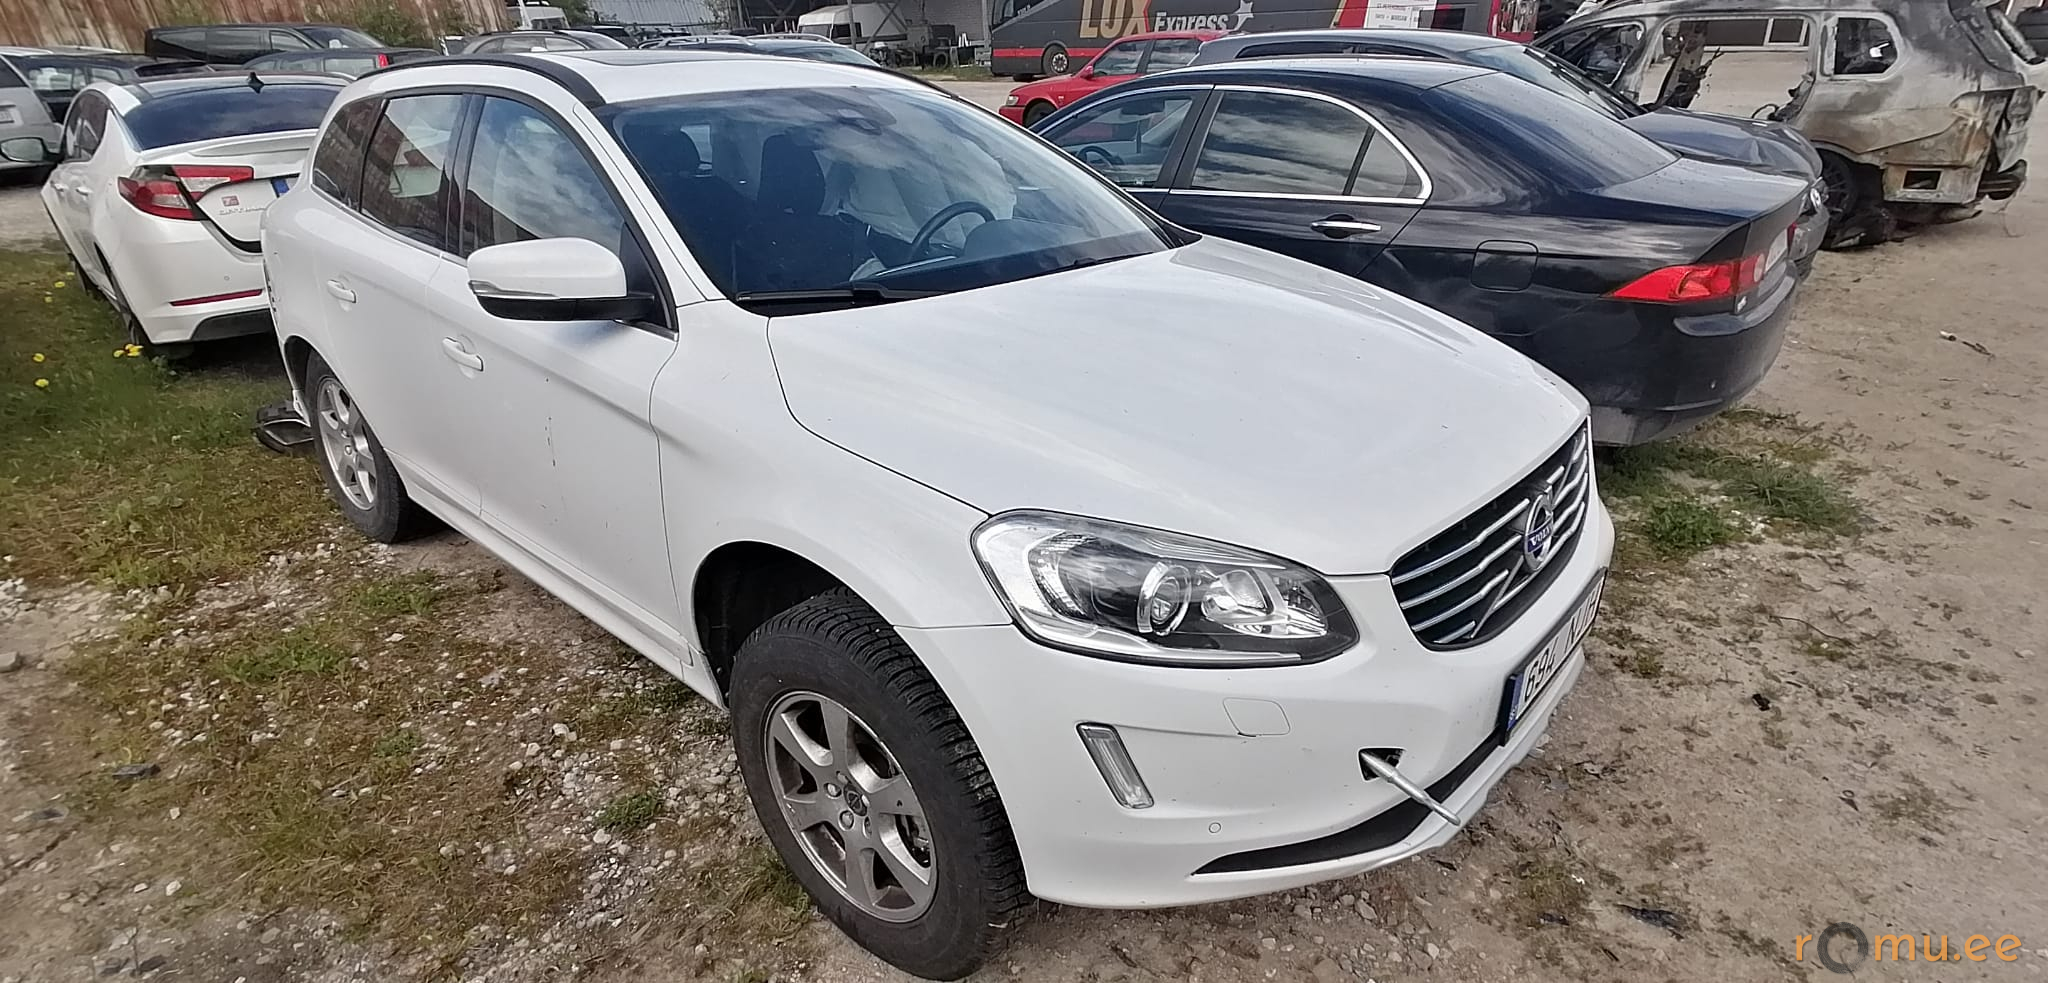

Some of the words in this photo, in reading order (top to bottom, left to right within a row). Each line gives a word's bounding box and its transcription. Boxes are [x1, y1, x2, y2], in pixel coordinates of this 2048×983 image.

[1079, 0, 1148, 38] LUX
[1154, 12, 1229, 32] Express
[1524, 636, 1559, 702] 694
